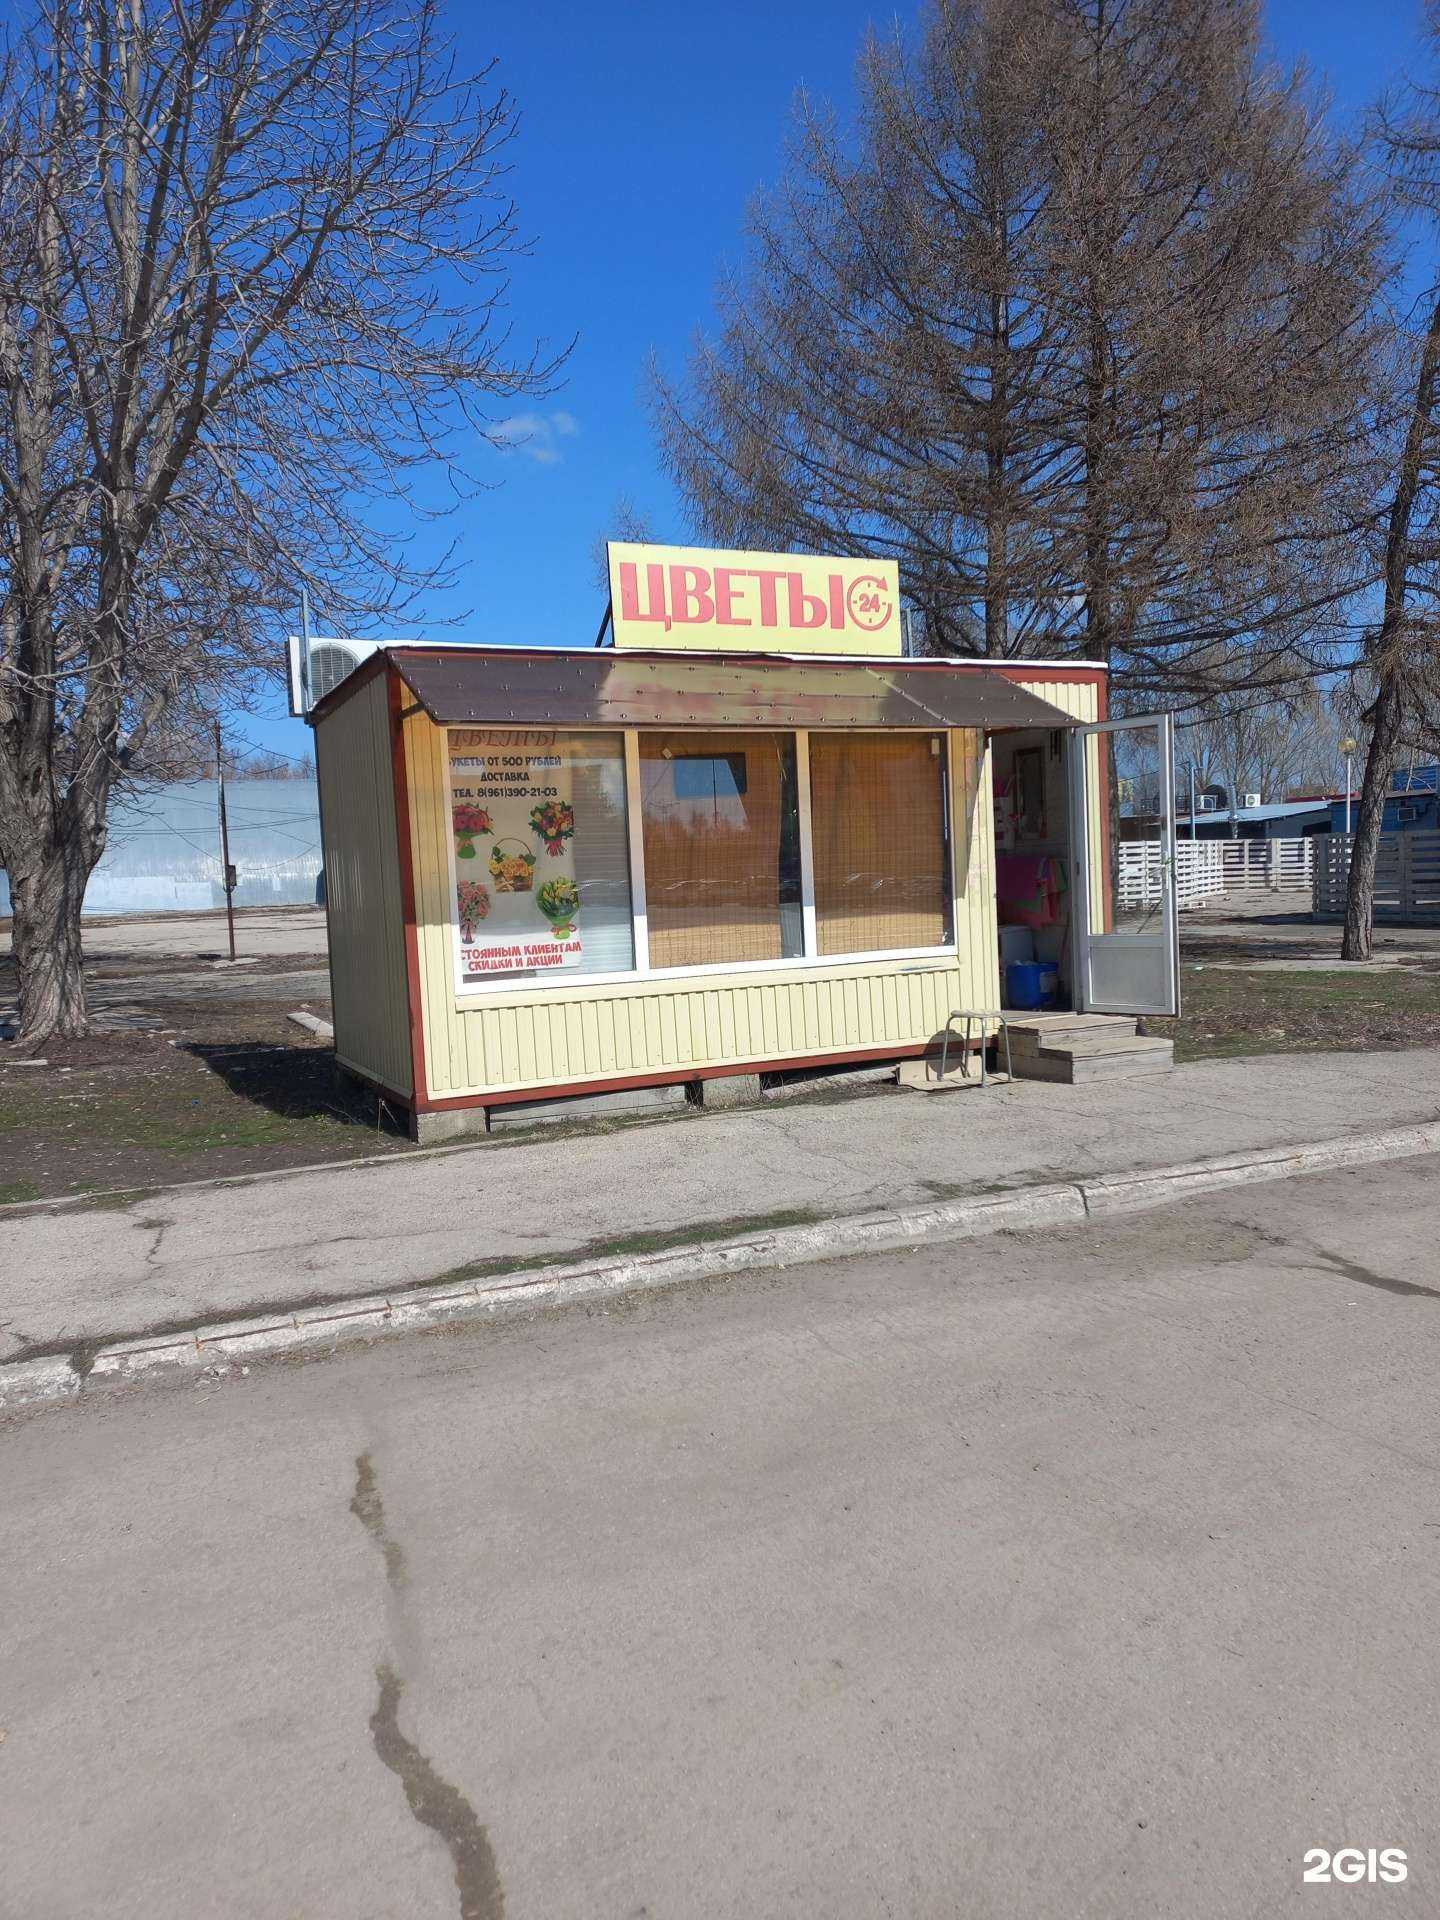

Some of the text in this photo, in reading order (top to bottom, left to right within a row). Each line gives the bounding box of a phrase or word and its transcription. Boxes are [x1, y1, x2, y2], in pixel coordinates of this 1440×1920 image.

[619, 562, 845, 632] ЦВЕТЫ
[859, 593, 880, 613] 24
[449, 755, 562, 767] УКЕТЫ ОТ 500 РУБЛЕЙ
[480, 772, 530, 782] ДОСТАВКА
[453, 787, 558, 798] ТЕЛ. 8(961)390-21-03
[524, 942, 582, 955] КЛИЕНТАМ
[468, 955, 563, 971] СКИДКИ И АКЦИИ
